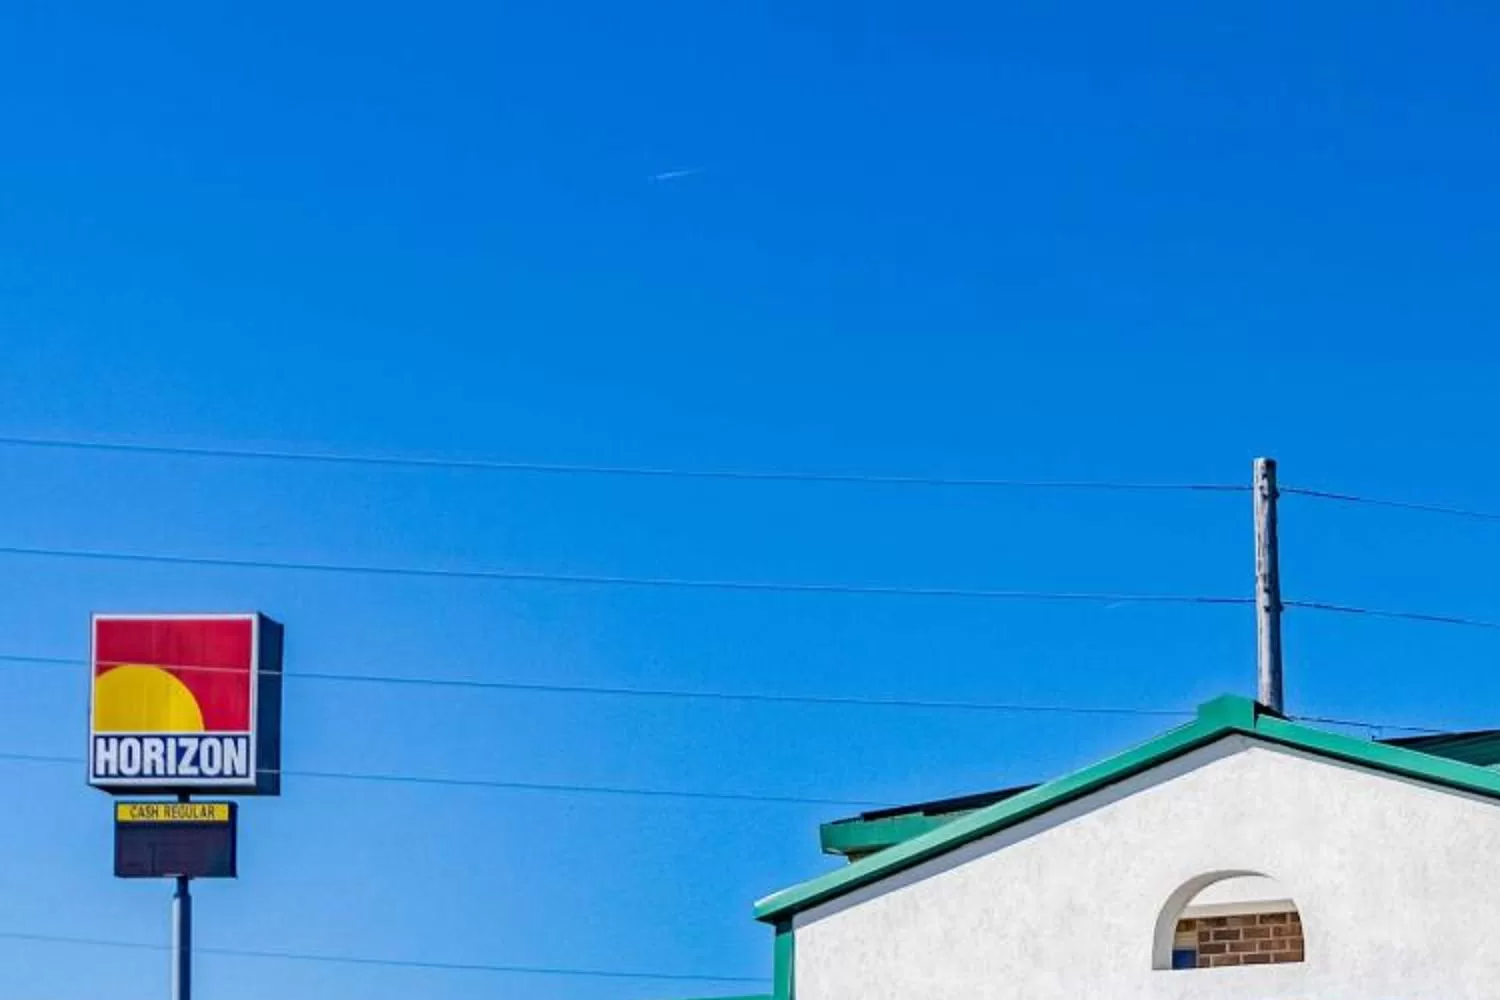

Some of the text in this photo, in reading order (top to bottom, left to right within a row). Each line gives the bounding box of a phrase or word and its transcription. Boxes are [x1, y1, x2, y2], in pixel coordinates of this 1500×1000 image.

[95, 737, 247, 776] HORIZON
[129, 804, 215, 819] CASH REGULAR
